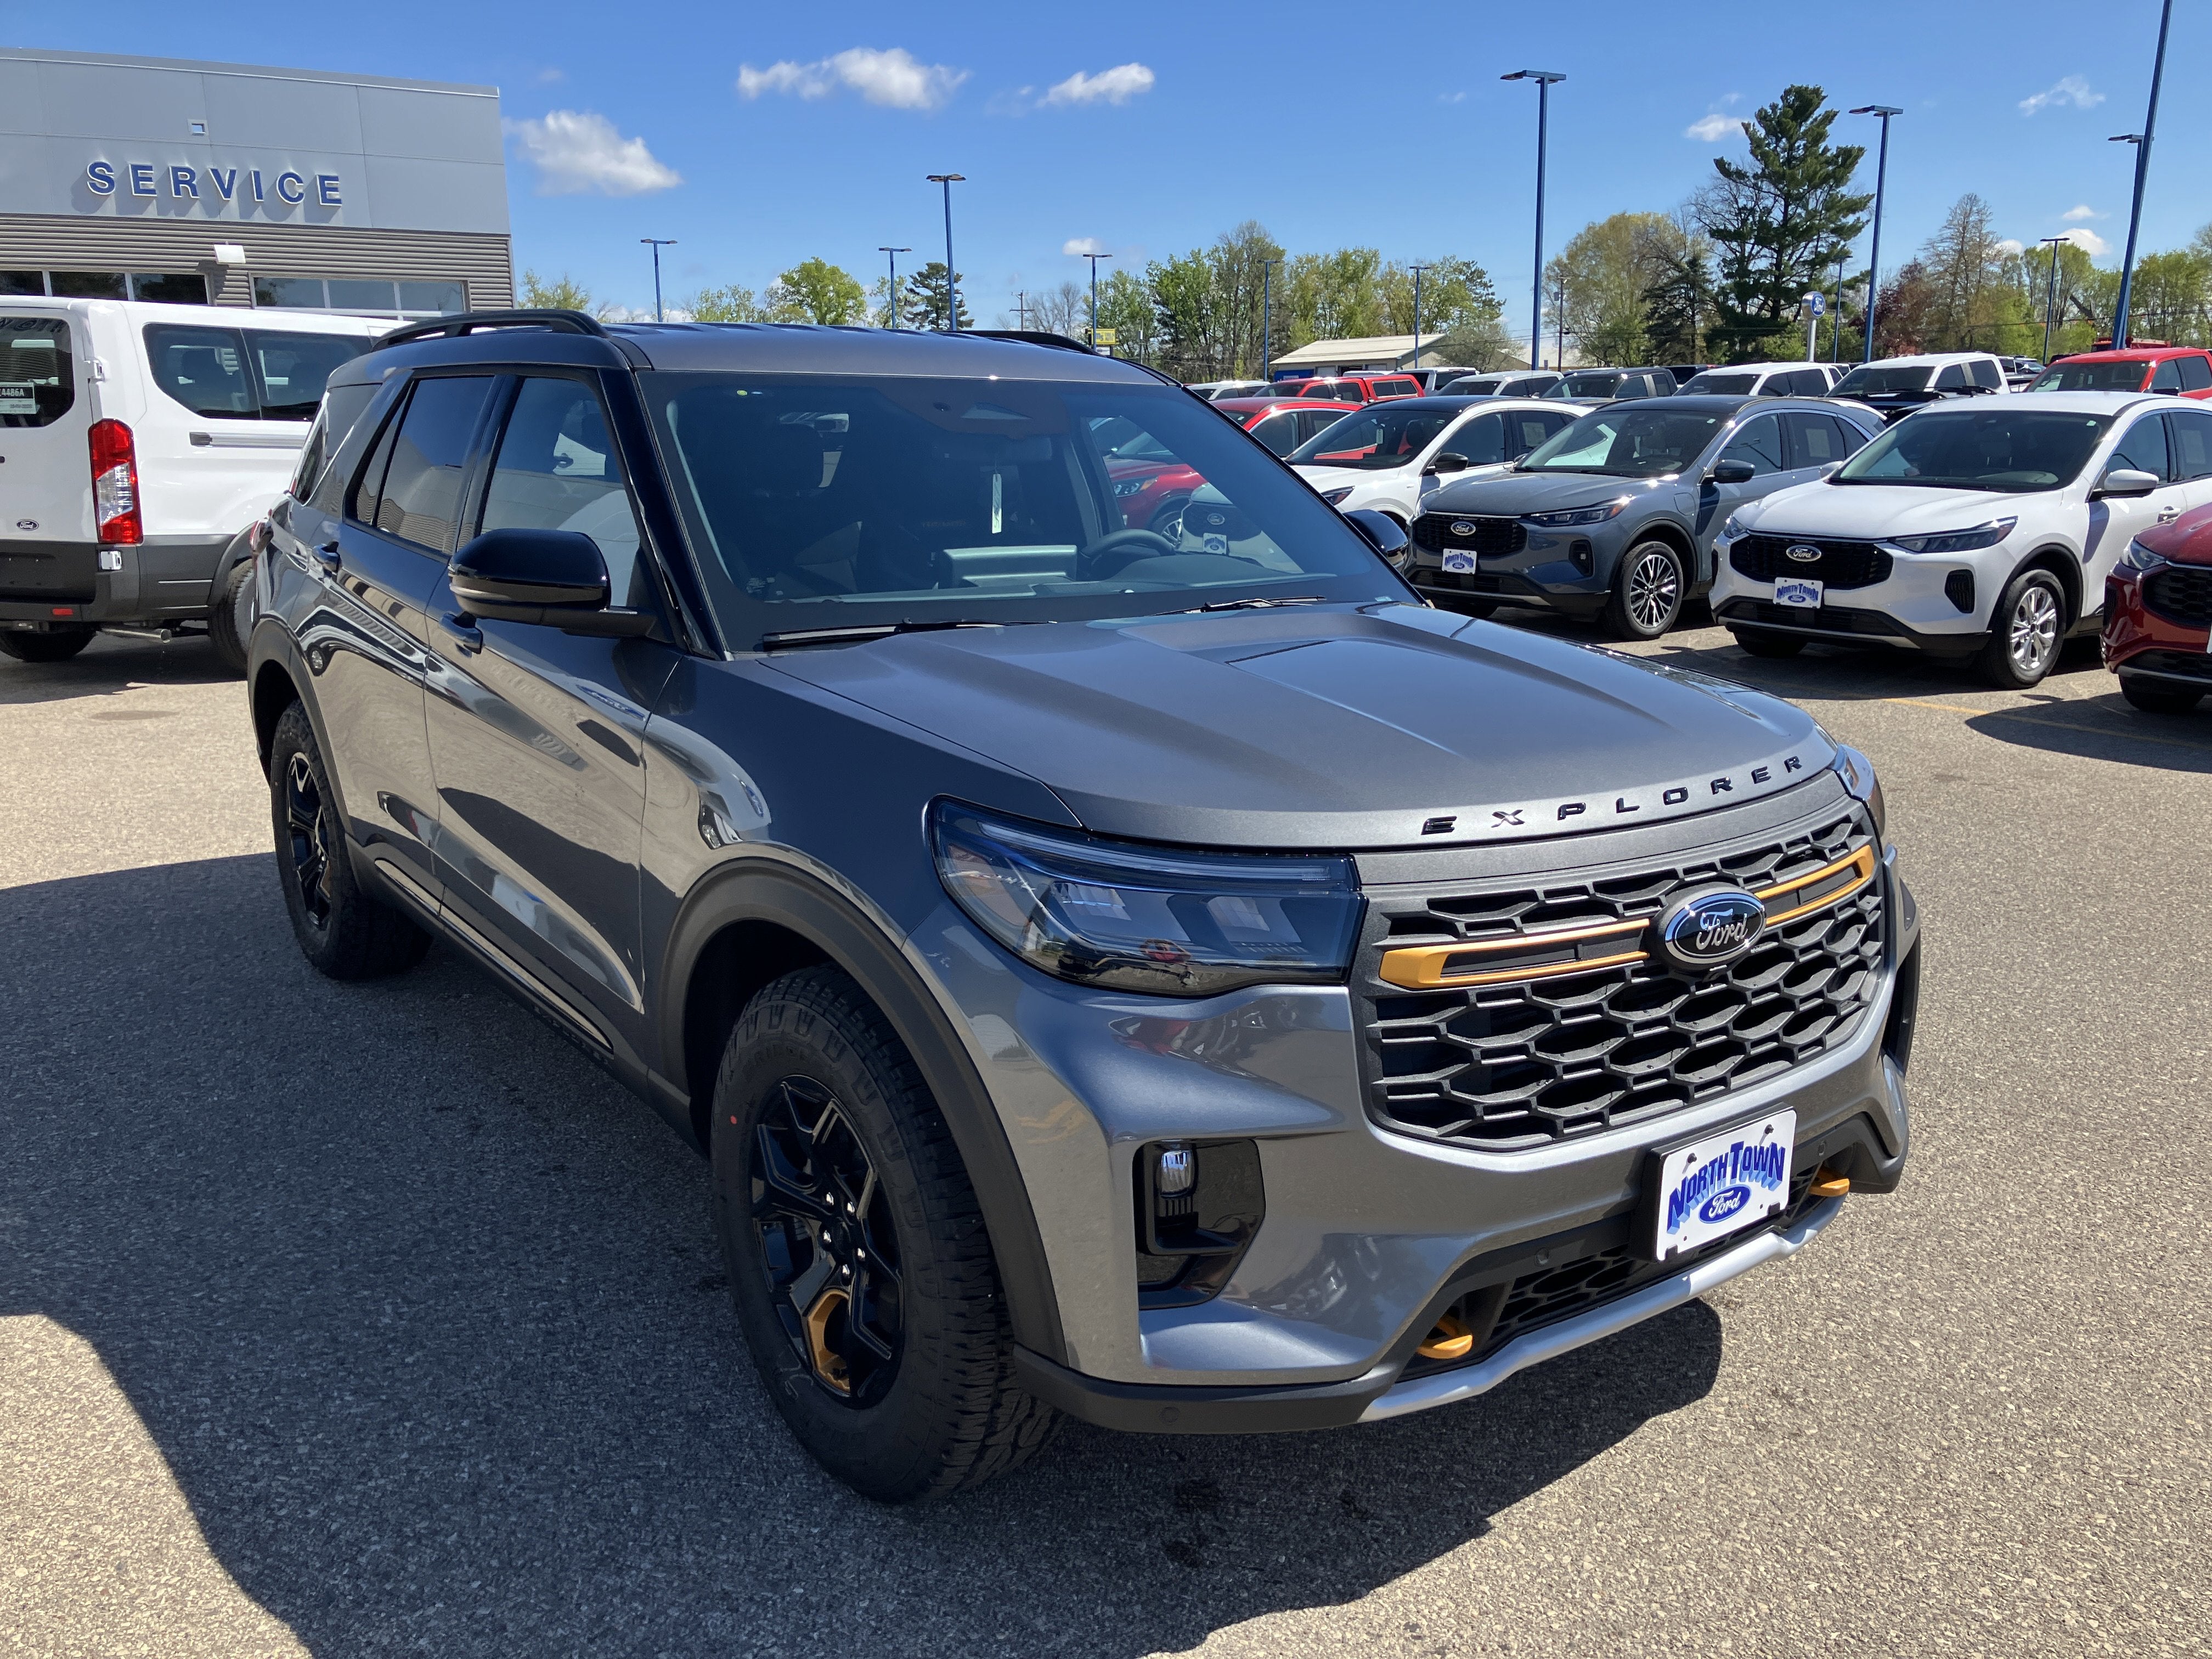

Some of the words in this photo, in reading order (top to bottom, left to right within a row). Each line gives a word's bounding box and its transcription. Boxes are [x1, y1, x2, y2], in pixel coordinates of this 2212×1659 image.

[87, 161, 342, 206] SERVICE
[1420, 755, 1803, 836] EXPLORER
[1696, 908, 1749, 950] Ford
[1708, 1190, 1742, 1219] Ford
